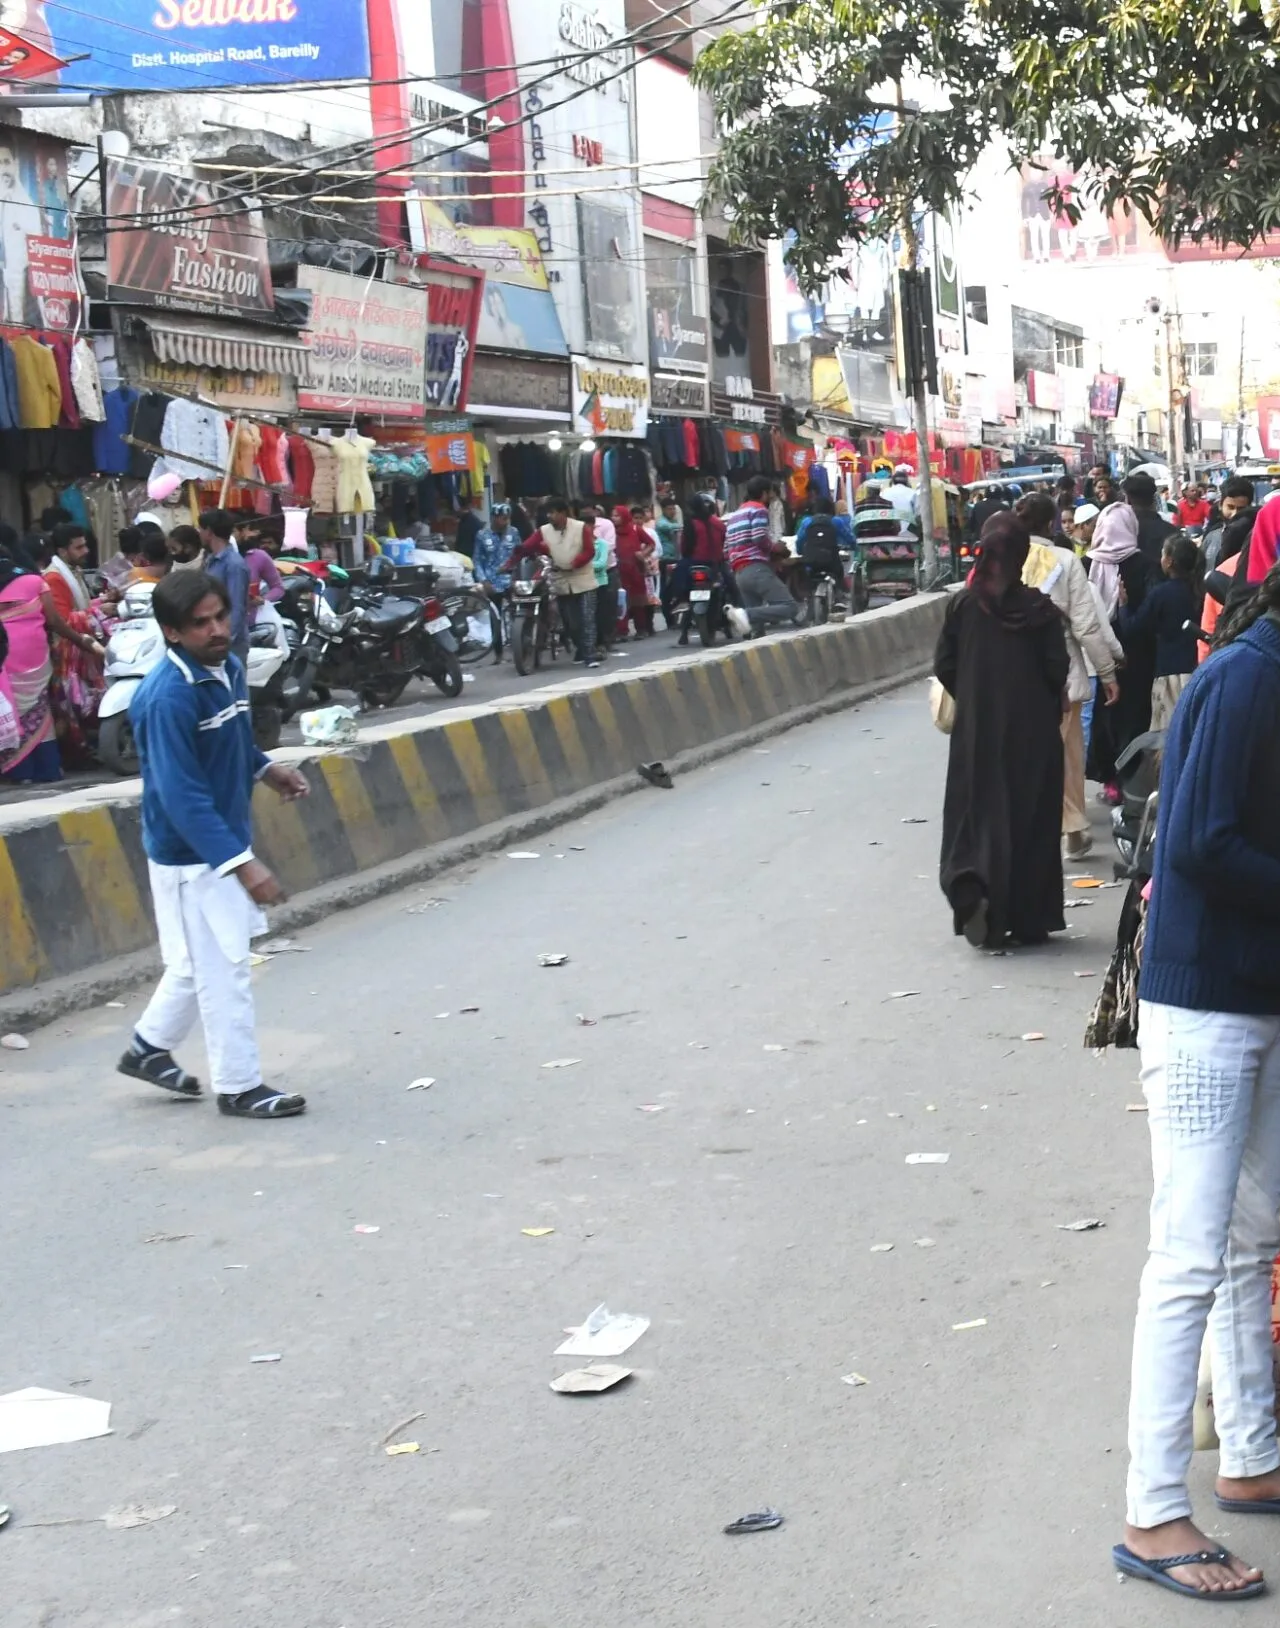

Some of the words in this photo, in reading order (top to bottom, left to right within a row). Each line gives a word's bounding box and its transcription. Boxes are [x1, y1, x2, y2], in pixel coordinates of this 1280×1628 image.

[169, 48, 224, 64] Hospital
[227, 45, 266, 61] Road,
[269, 43, 320, 59] Bareilly
[172, 246, 258, 298] Fashion
[360, 376, 396, 397] Medical
[398, 378, 420, 400] Store
